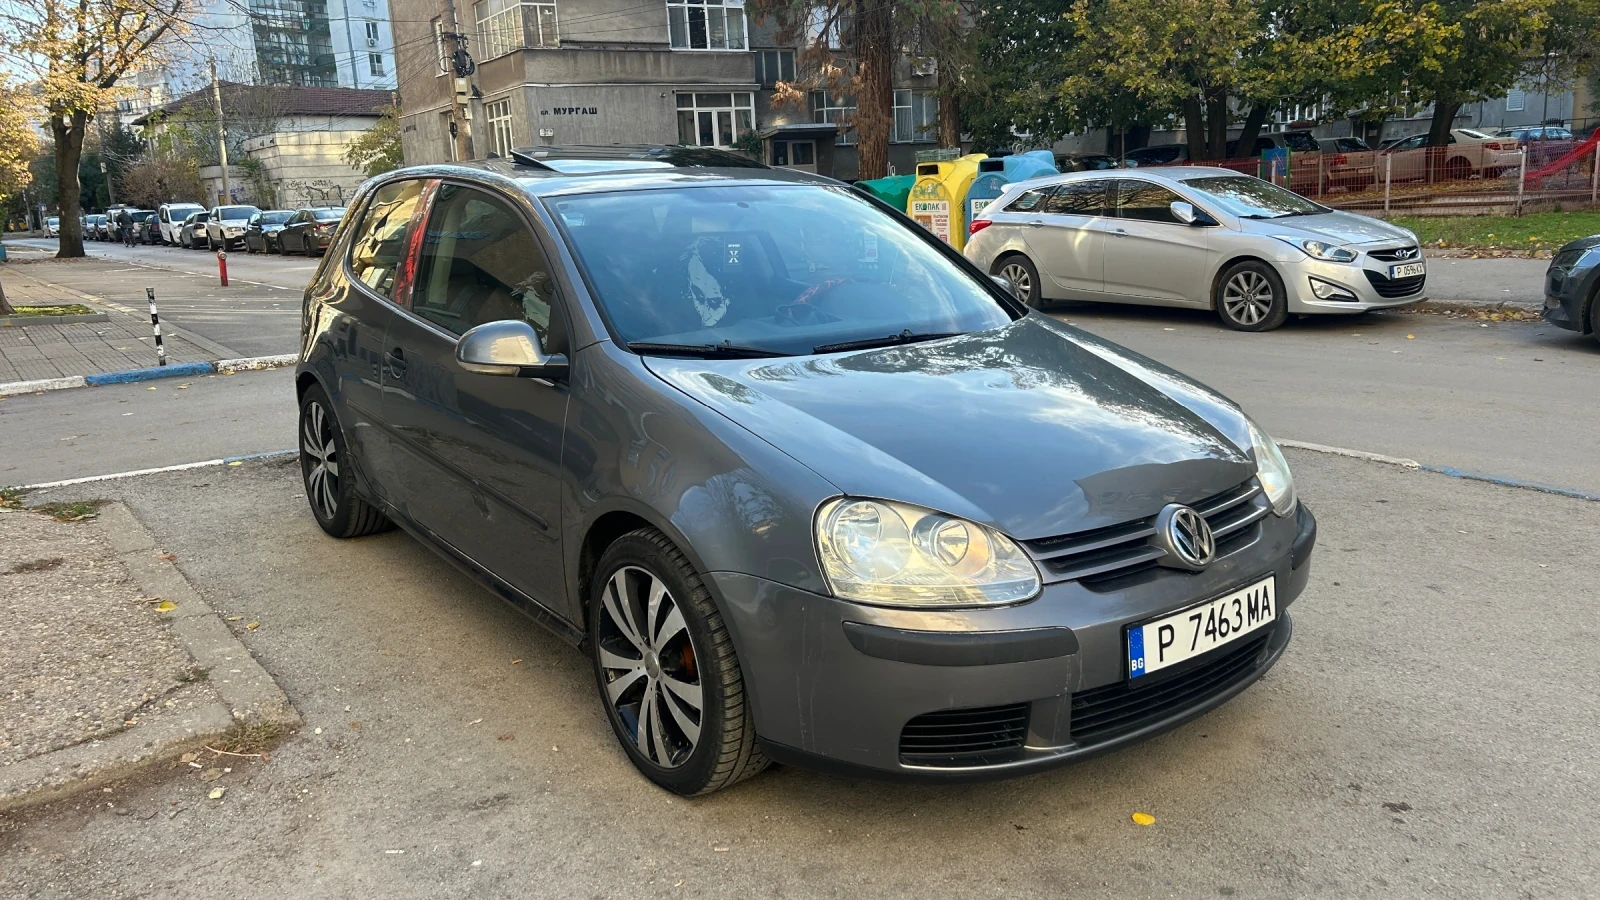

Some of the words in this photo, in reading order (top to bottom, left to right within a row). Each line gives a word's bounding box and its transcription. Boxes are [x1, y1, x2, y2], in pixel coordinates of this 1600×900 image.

[553, 107, 598, 115] МУРГАШ
[915, 202, 940, 211] ЕКОПАК
[1158, 624, 1175, 662] P
[1188, 598, 1243, 652] 7463
[1247, 585, 1272, 627] MA
[1131, 657, 1144, 672] BG
